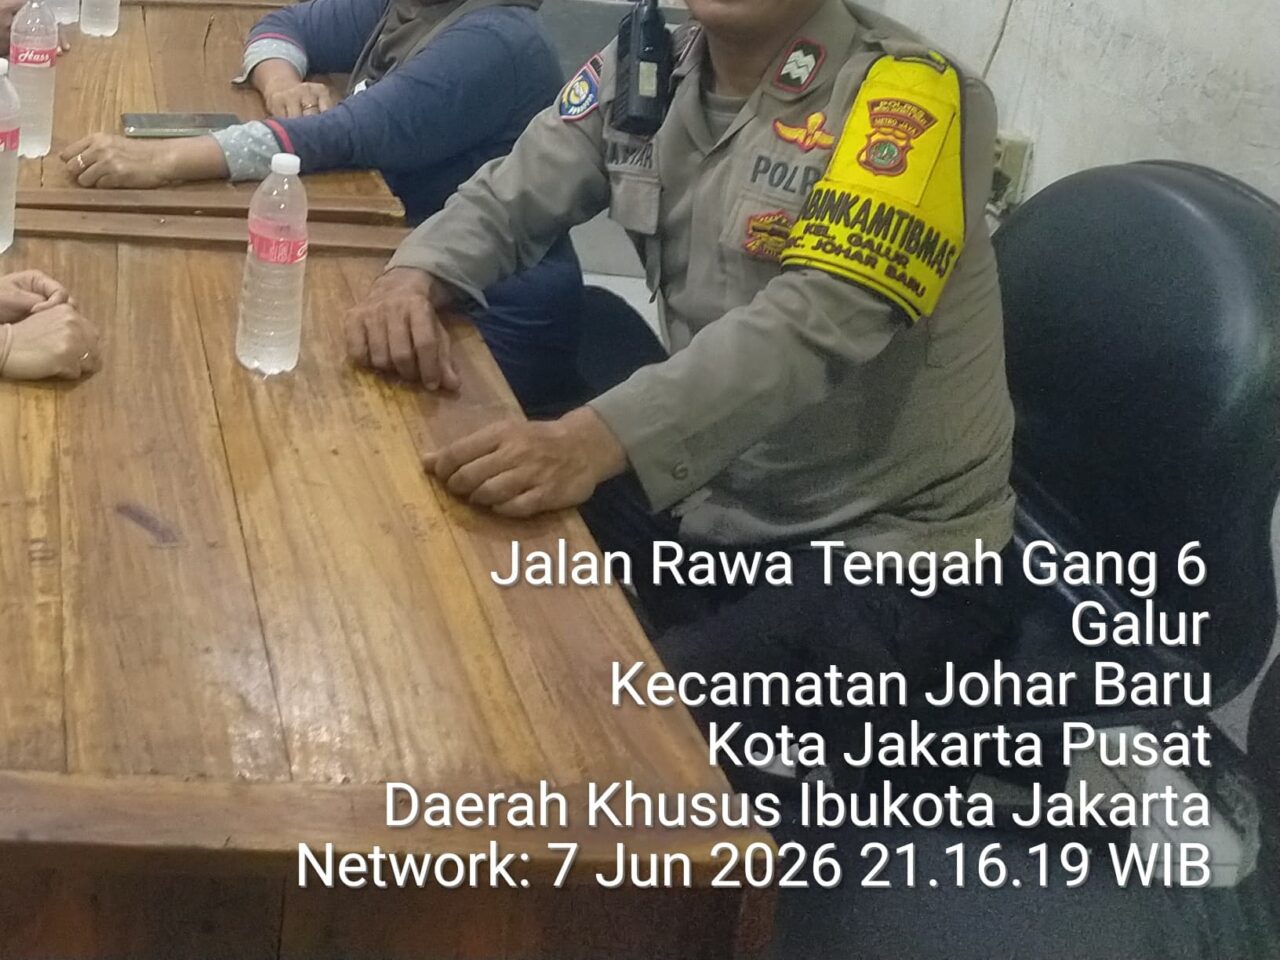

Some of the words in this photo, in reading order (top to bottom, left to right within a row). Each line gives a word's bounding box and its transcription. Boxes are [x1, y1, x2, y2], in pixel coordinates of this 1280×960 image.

[18, 50, 50, 62] Hass
[898, 122, 917, 136] JAYA
[750, 155, 821, 196] POLR
[803, 222, 836, 240] KEL.
[847, 233, 910, 266] GALUR
[811, 238, 879, 269] JOHAR
[885, 263, 928, 298] BARU
